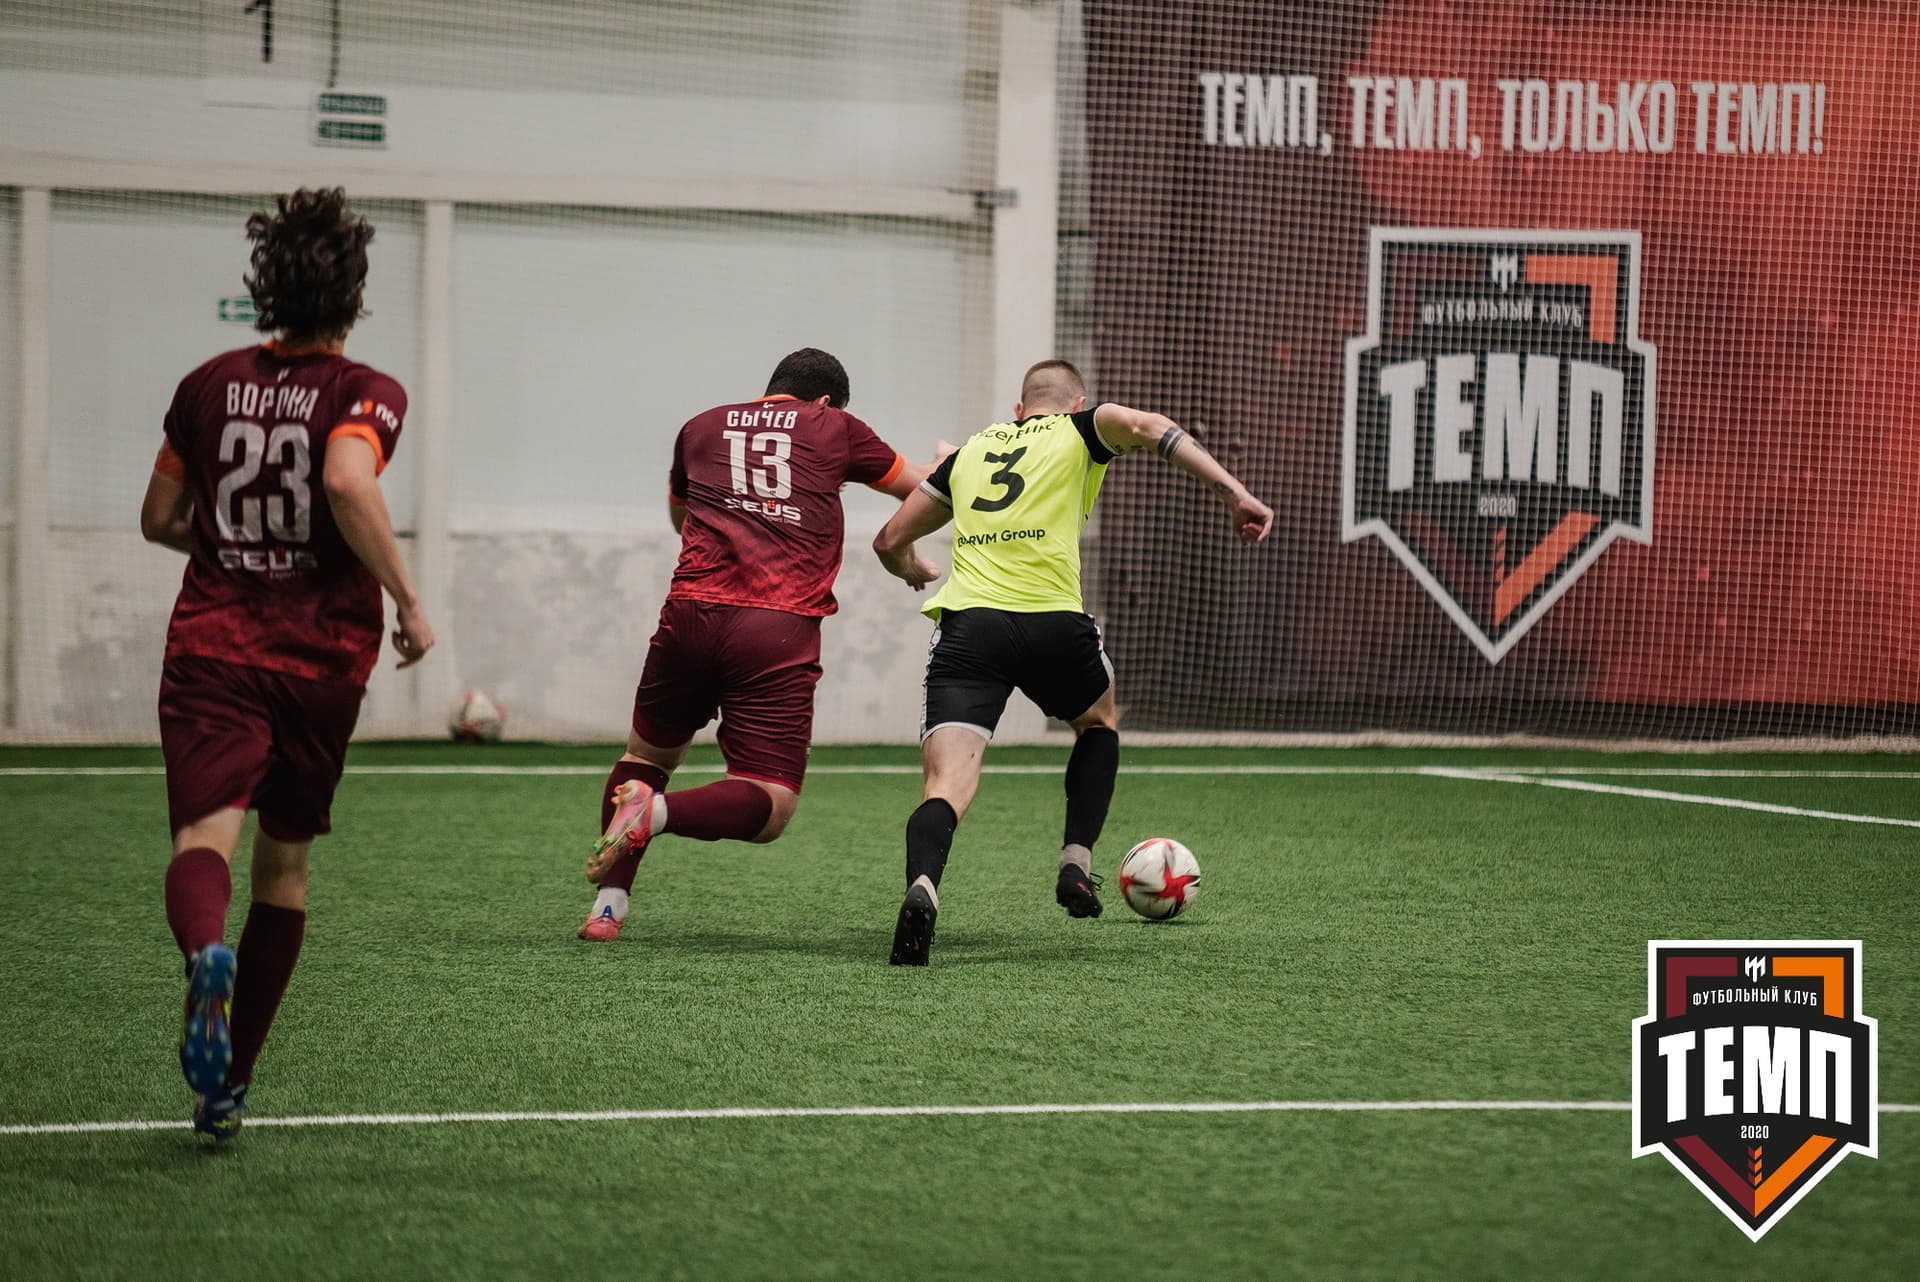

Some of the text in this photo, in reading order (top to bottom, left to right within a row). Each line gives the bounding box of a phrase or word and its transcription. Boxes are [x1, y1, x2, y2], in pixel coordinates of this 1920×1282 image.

[1200, 72, 1825, 159] ТЕМП, ТЕМП, ТОЛЬКО ТЕМП!
[1424, 296, 1583, 328] ФУТБОЛЬНЫЙ КЛУБ
[726, 410, 798, 429] СЫЧЕВ
[1380, 353, 1624, 498] ТЕМП
[216, 420, 311, 543] 23
[722, 430, 792, 500] 13
[970, 446, 1028, 512] 3
[1000, 529, 1046, 541] Group
[1479, 496, 1517, 516] 2020
